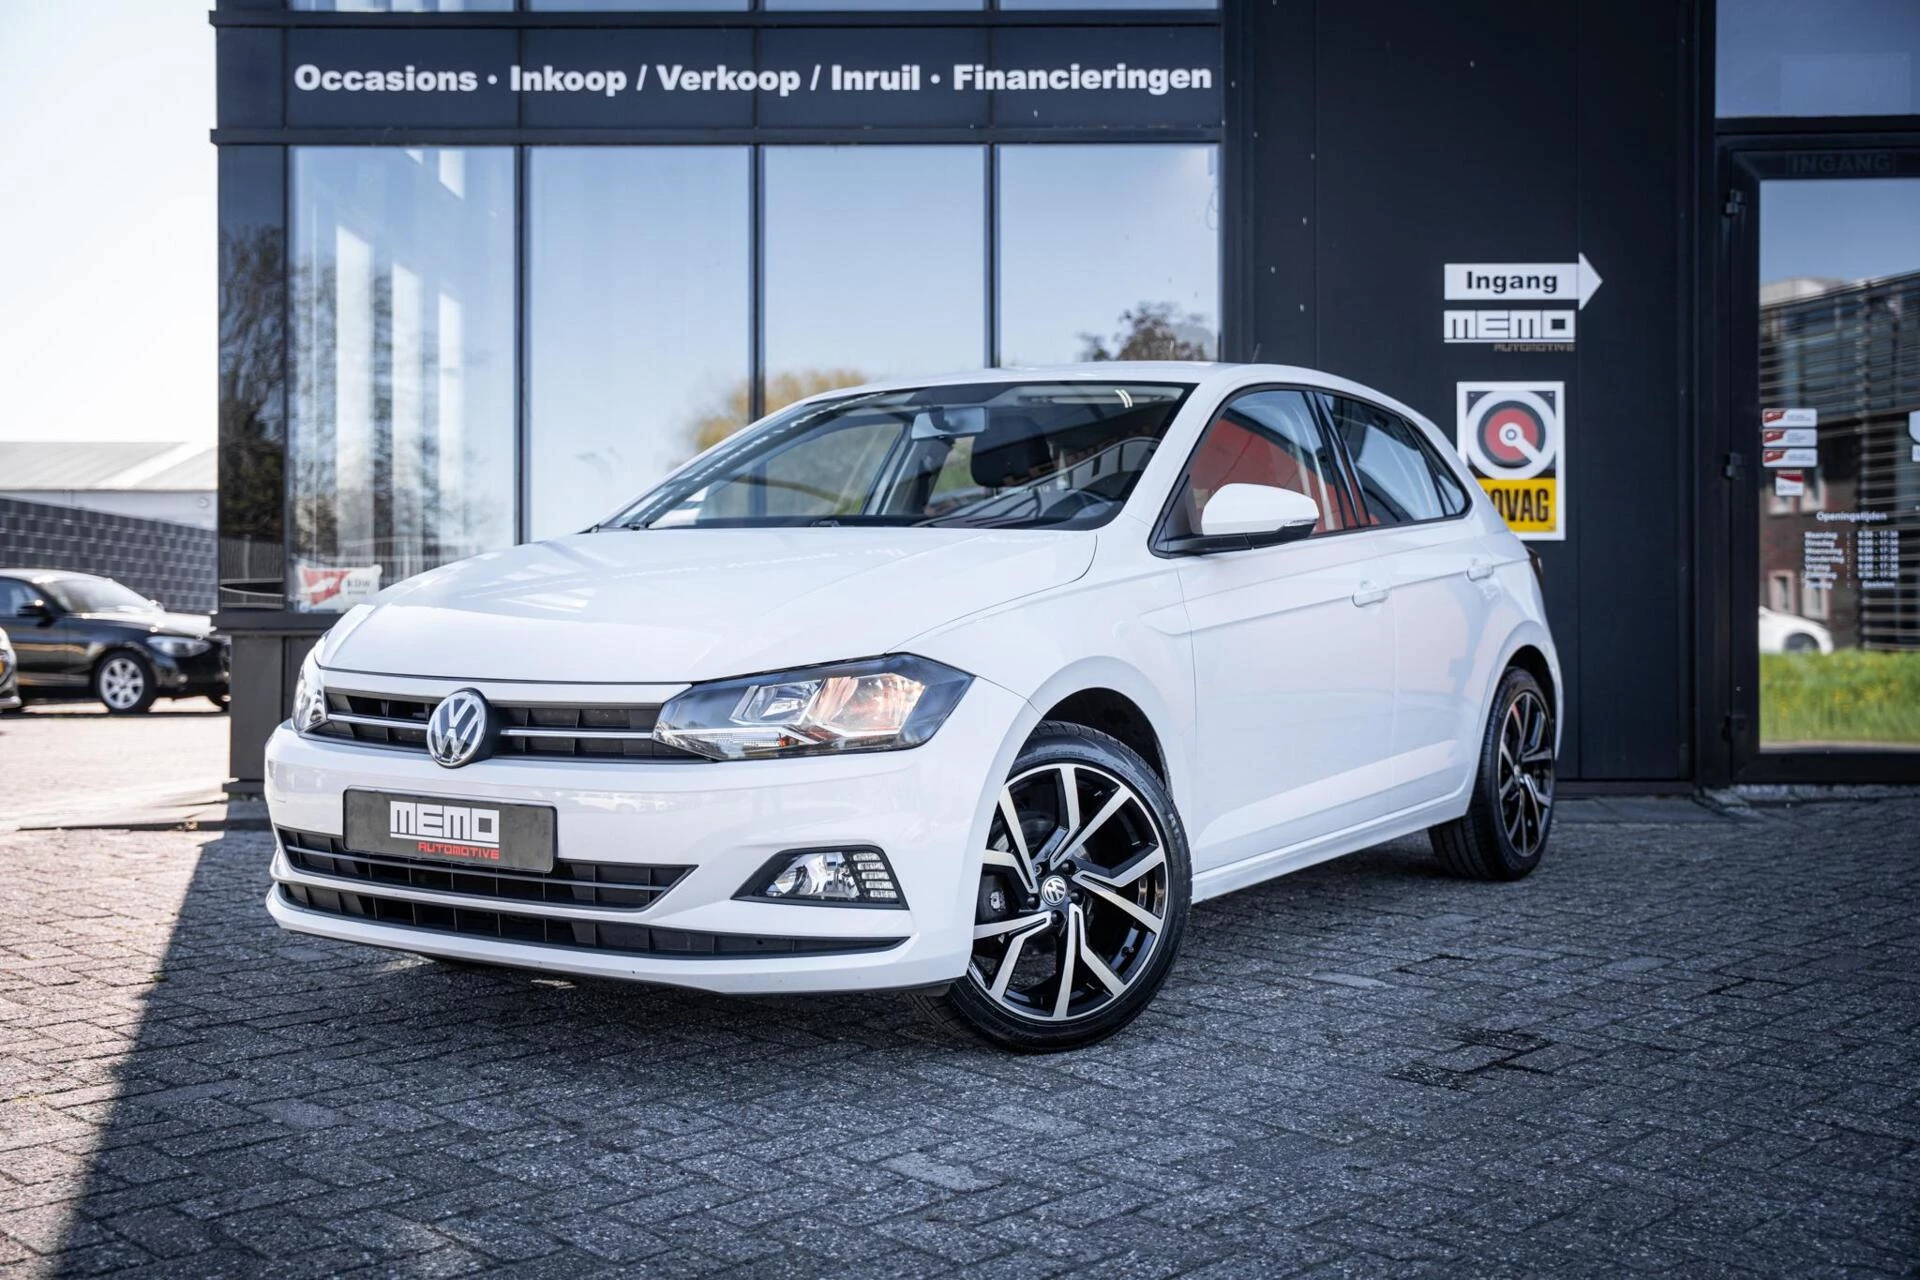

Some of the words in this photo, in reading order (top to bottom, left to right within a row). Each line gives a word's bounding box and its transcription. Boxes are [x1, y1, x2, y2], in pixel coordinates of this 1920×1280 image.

[294, 64, 478, 92] Occasions
[510, 65, 628, 97] Inkoop
[656, 64, 801, 97] Verkoop
[831, 64, 920, 91] Inruil
[953, 63, 1212, 96] Financieringen
[1791, 152, 1890, 174] INGANG
[1467, 271, 1558, 294] Ingang
[1444, 309, 1576, 342] MEMO
[1486, 488, 1550, 523] OVAG
[390, 800, 500, 843] MEMO
[417, 840, 501, 860] AUTOMOTIVE
